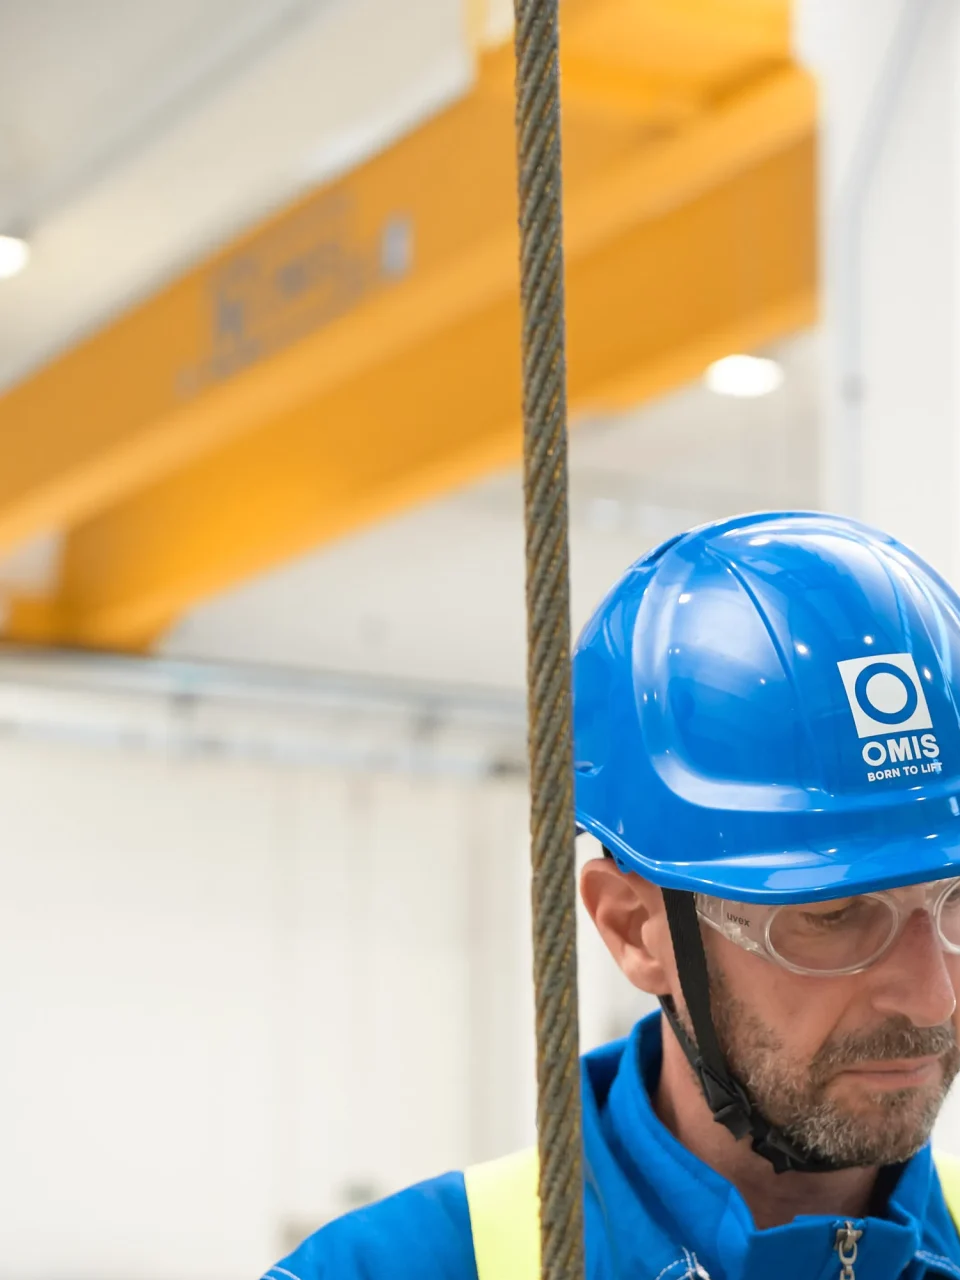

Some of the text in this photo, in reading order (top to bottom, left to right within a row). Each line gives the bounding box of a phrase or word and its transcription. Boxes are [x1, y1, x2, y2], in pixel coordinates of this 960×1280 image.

[862, 733, 940, 767] OMIS
[867, 762, 943, 782] BORN TO LIFT
[726, 912, 751, 927] uvex
